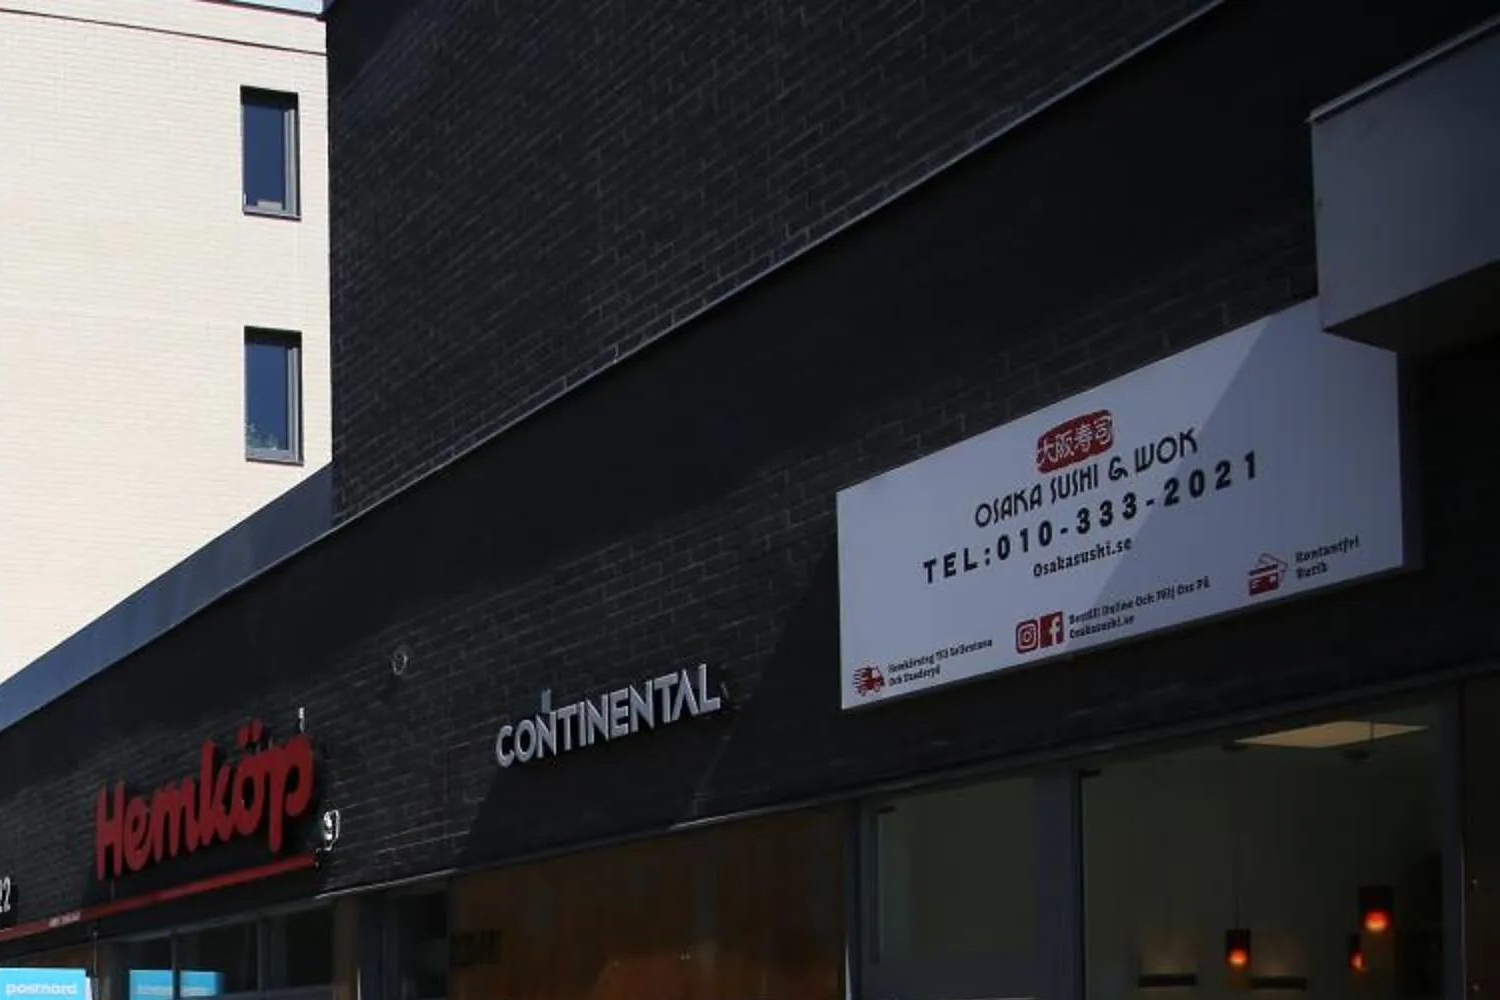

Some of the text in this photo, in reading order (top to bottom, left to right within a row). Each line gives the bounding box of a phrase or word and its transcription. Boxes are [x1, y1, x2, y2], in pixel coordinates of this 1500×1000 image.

[1037, 415, 1114, 465] 大阪寿司
[974, 427, 1199, 528] OSAKA SUSHI & WOK
[1033, 537, 1133, 578] Osakasushi.se
[1135, 592, 1155, 608] Och
[495, 663, 722, 768] CONTINENTAL
[95, 717, 314, 880] Hemköp
[4, 981, 78, 997] postnord
